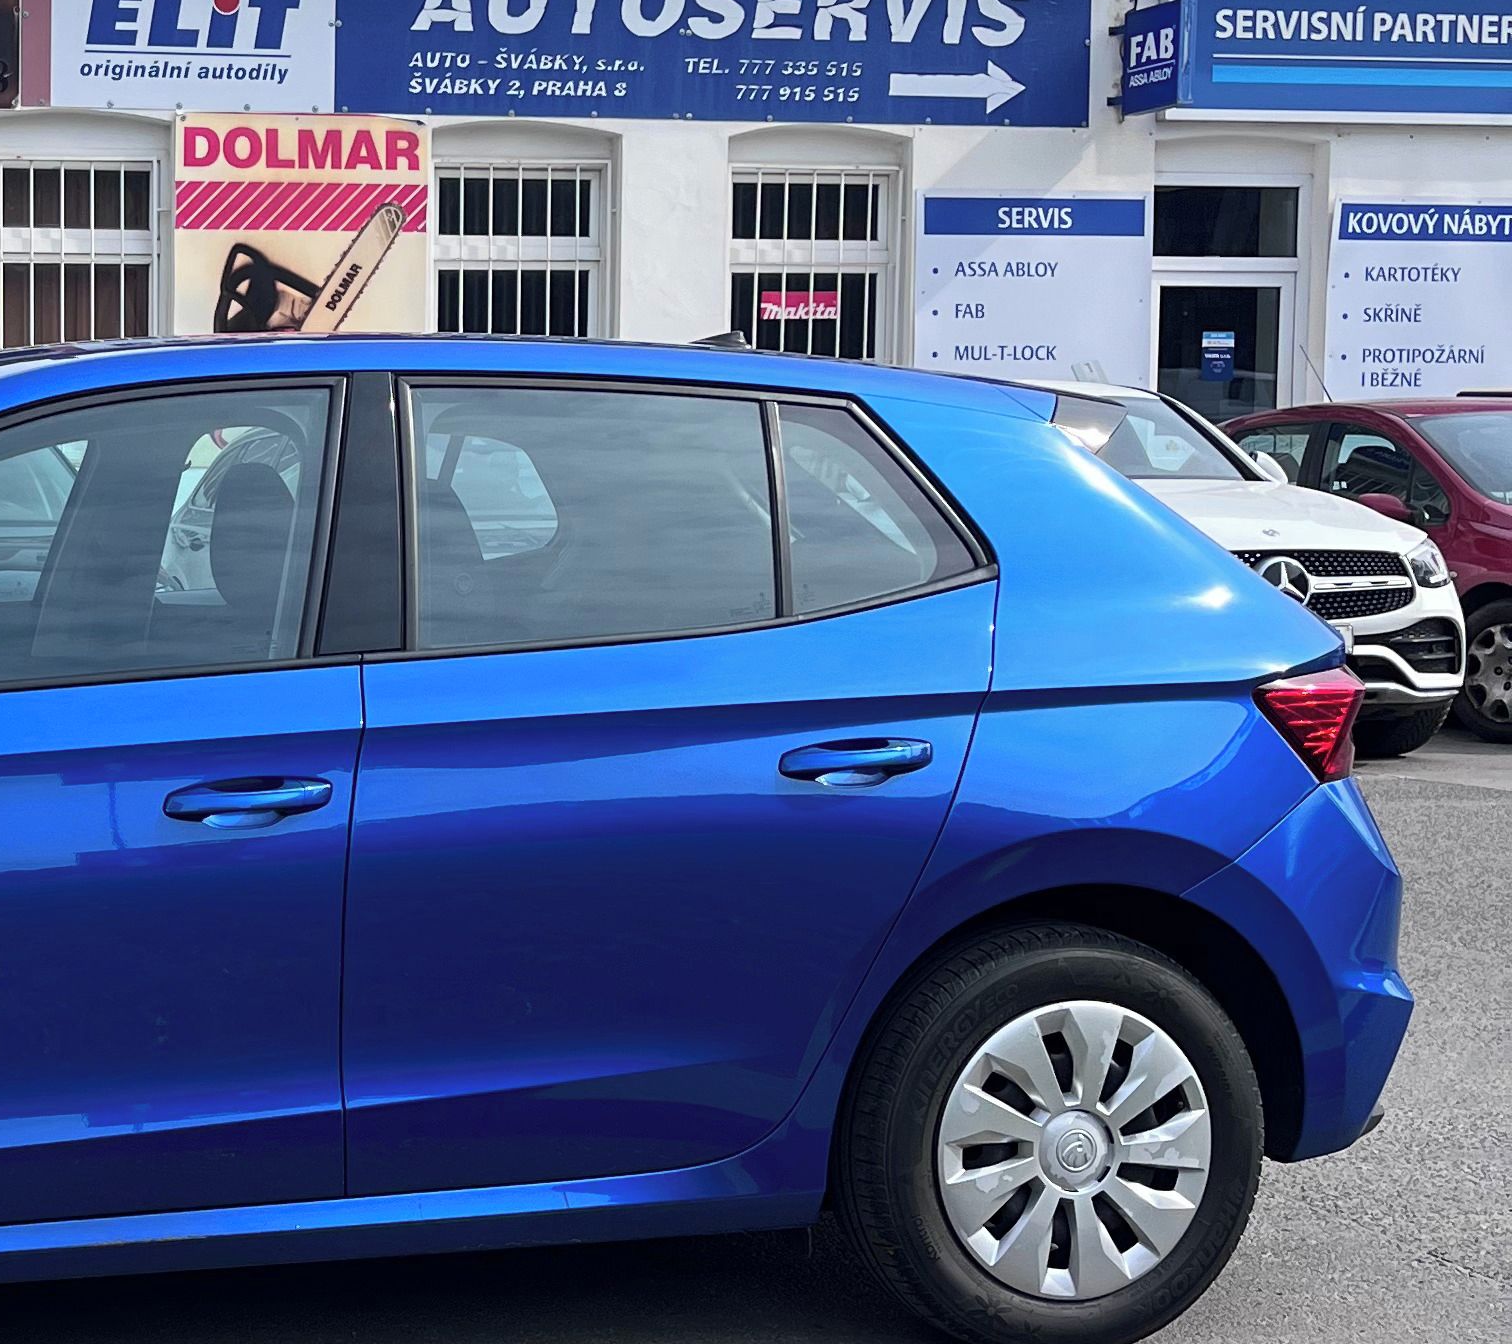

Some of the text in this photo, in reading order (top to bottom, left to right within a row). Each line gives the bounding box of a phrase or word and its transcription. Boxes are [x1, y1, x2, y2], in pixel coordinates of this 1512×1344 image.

[1215, 6, 1367, 41] SERVISNÍ
[1129, 27, 1175, 68] FAB
[408, 52, 471, 68] AUTO
[493, 47, 589, 74] ŠVÁBKY,
[685, 58, 863, 77] TEL. 777 335 515
[79, 59, 289, 85] originální autodíly
[408, 72, 501, 94] ŠVÁBKY
[506, 79, 525, 99] 2,
[531, 79, 608, 97] PRAHA
[735, 85, 861, 102] 777 915 515
[183, 126, 420, 171] DOLMAR
[997, 207, 1073, 229] SERVIS
[1347, 208, 1439, 234] KOVOVÝ
[954, 261, 1059, 278] ASSA ABLOY
[1364, 262, 1462, 282] KARTOTÉKY
[324, 262, 363, 312] DOLMAR
[954, 303, 985, 319] FAB
[1363, 303, 1423, 323] SKŘÍNĚ
[954, 345, 1058, 361] MUL-T-LOCK
[1361, 344, 1486, 364] PROTIPOŽÁRNÍ
[1370, 368, 1423, 387] BĚŽNÉ
